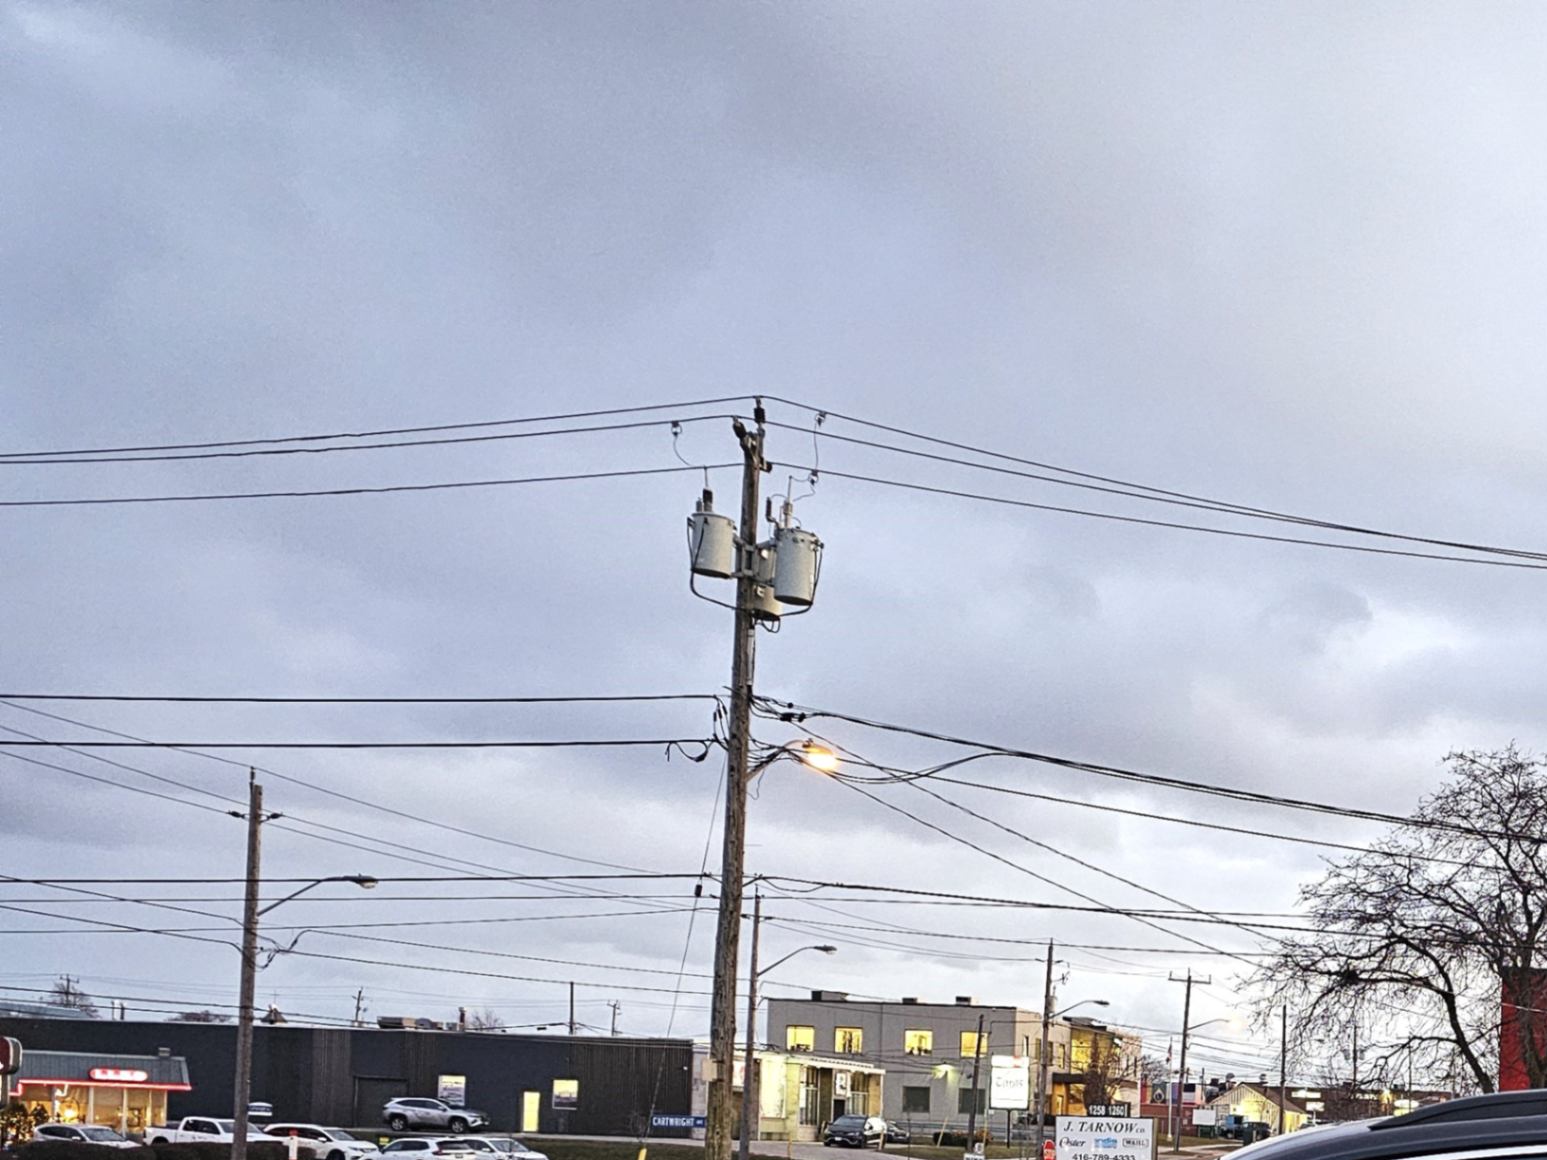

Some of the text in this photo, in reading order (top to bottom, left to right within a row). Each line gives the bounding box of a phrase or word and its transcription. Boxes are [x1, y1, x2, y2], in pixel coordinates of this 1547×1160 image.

[1089, 1105, 1106, 1116] 1258
[652, 1116, 694, 1127] CARTWRIGHT
[1063, 1121, 1074, 1132] J.
[1078, 1122, 1137, 1133] TARNOW
